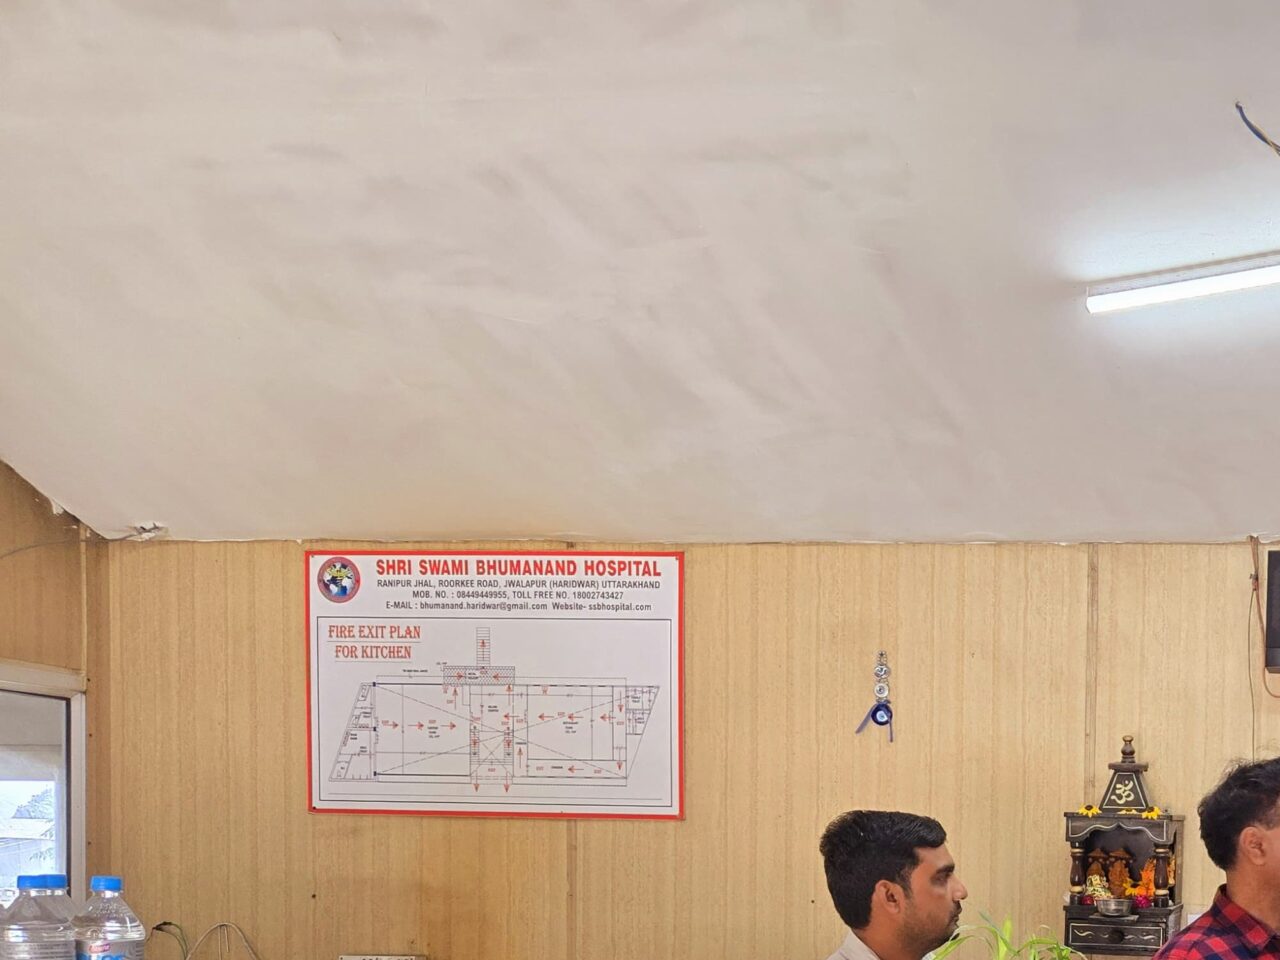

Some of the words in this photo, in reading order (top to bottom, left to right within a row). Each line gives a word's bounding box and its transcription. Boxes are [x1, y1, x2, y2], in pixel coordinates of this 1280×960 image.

[376, 559, 412, 575] SHRI
[419, 559, 469, 576] SWAMI
[476, 559, 577, 576] BHUMANAND
[584, 560, 662, 576] HOSPITAL
[377, 579, 412, 588] RANIPUR
[414, 579, 436, 589] JHAL,
[438, 579, 475, 588] ROORKEE
[477, 579, 501, 589] ROAD,
[503, 580, 547, 588] JWALAPUR
[549, 580, 599, 590] (HARIDWAR)
[601, 580, 660, 589] UTTARAKHAND
[412, 590, 433, 599] MOB.
[435, 590, 449, 599] NO.
[456, 590, 510, 600] 08449449955,
[512, 591, 532, 599] TOLL
[533, 591, 554, 599] FREE
[556, 591, 570, 600] NO.
[573, 591, 624, 600] 18002743427
[386, 601, 412, 609] E-MAIL
[420, 601, 548, 611] bhumanand.haridwar@gmail.com
[552, 602, 587, 610] Website-
[588, 602, 652, 612] ssbhospital.com
[328, 625, 355, 638] FIRE
[358, 625, 386, 639] EXIT
[389, 625, 421, 639] PLAN
[335, 645, 358, 659] FOR
[361, 645, 411, 659] KITCHEN
